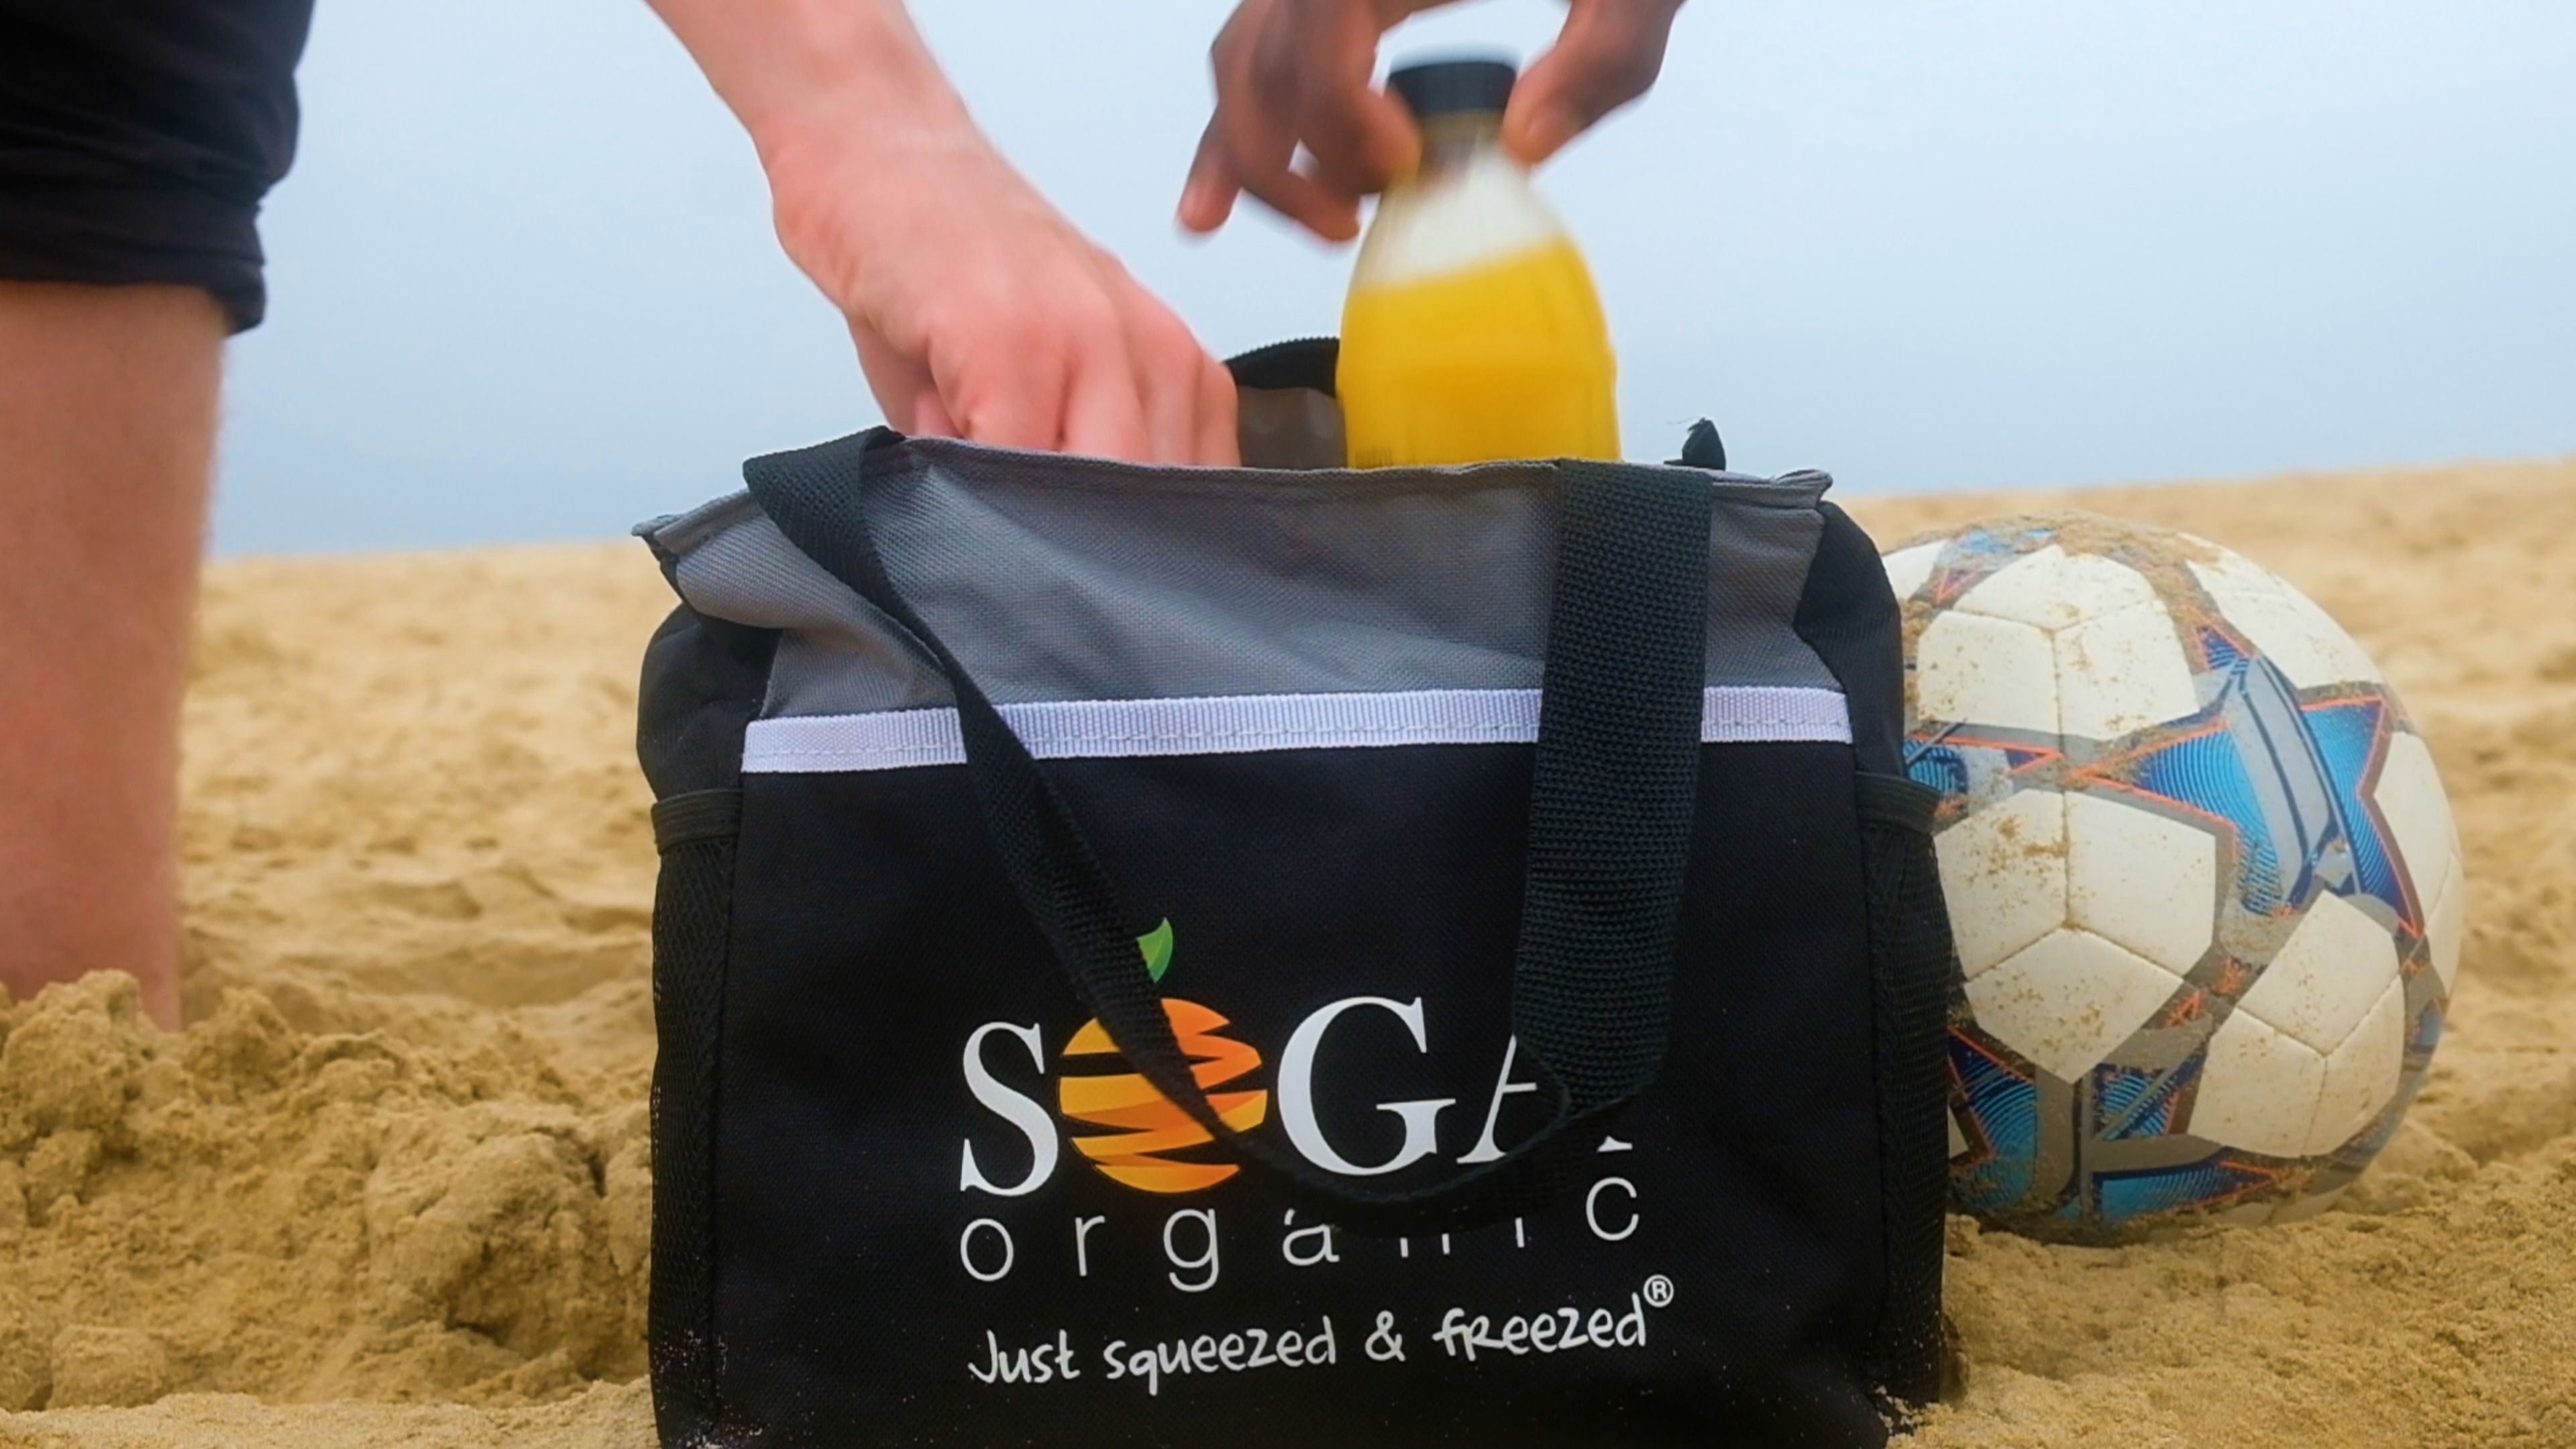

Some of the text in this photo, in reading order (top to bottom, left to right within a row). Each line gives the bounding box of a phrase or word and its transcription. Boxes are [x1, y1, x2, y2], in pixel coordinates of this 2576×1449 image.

[960, 1177, 1639, 1292] orgac
[967, 1330, 1081, 1383] Just
[1103, 1315, 1336, 1396] squeezed
[1364, 1310, 1405, 1362] &
